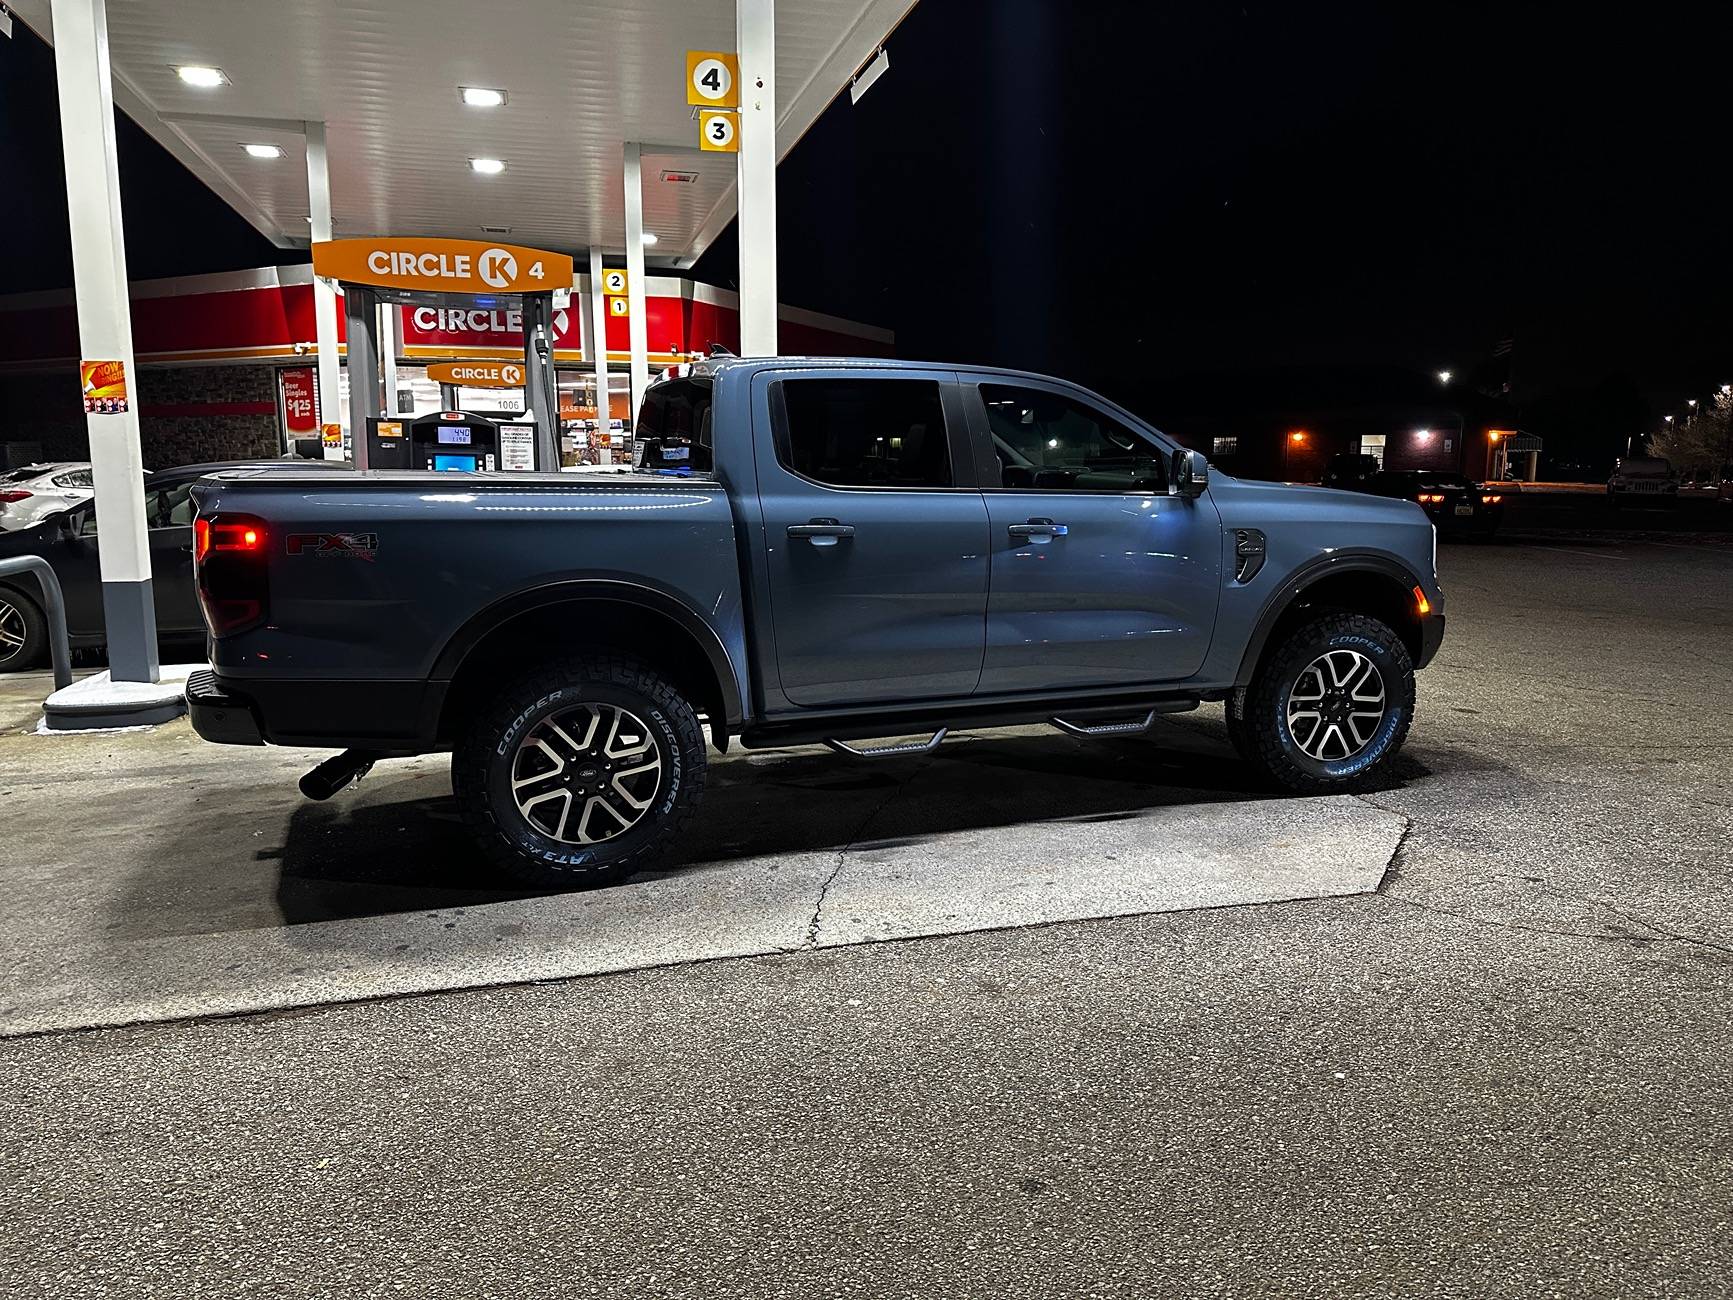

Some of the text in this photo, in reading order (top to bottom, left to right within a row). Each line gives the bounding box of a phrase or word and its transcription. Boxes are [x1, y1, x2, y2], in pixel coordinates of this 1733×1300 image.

[701, 68, 721, 91] 4
[712, 122, 726, 140] 3
[367, 250, 545, 287] CIRCLE K 4
[611, 276, 621, 287] 2
[616, 302, 622, 311] 1
[413, 306, 523, 333] CIRCLE
[97, 362, 119, 377] NOW
[451, 366, 520, 382] CIRCLE K
[285, 382, 299, 390] Beer
[286, 389, 308, 397] Singles
[498, 400, 519, 409] 1006
[286, 533, 378, 555] FX4
[1329, 636, 1384, 654] COOPER
[497, 690, 562, 755] COOPER
[651, 710, 681, 814] DISCOVERER
[543, 851, 586, 865] AT3
